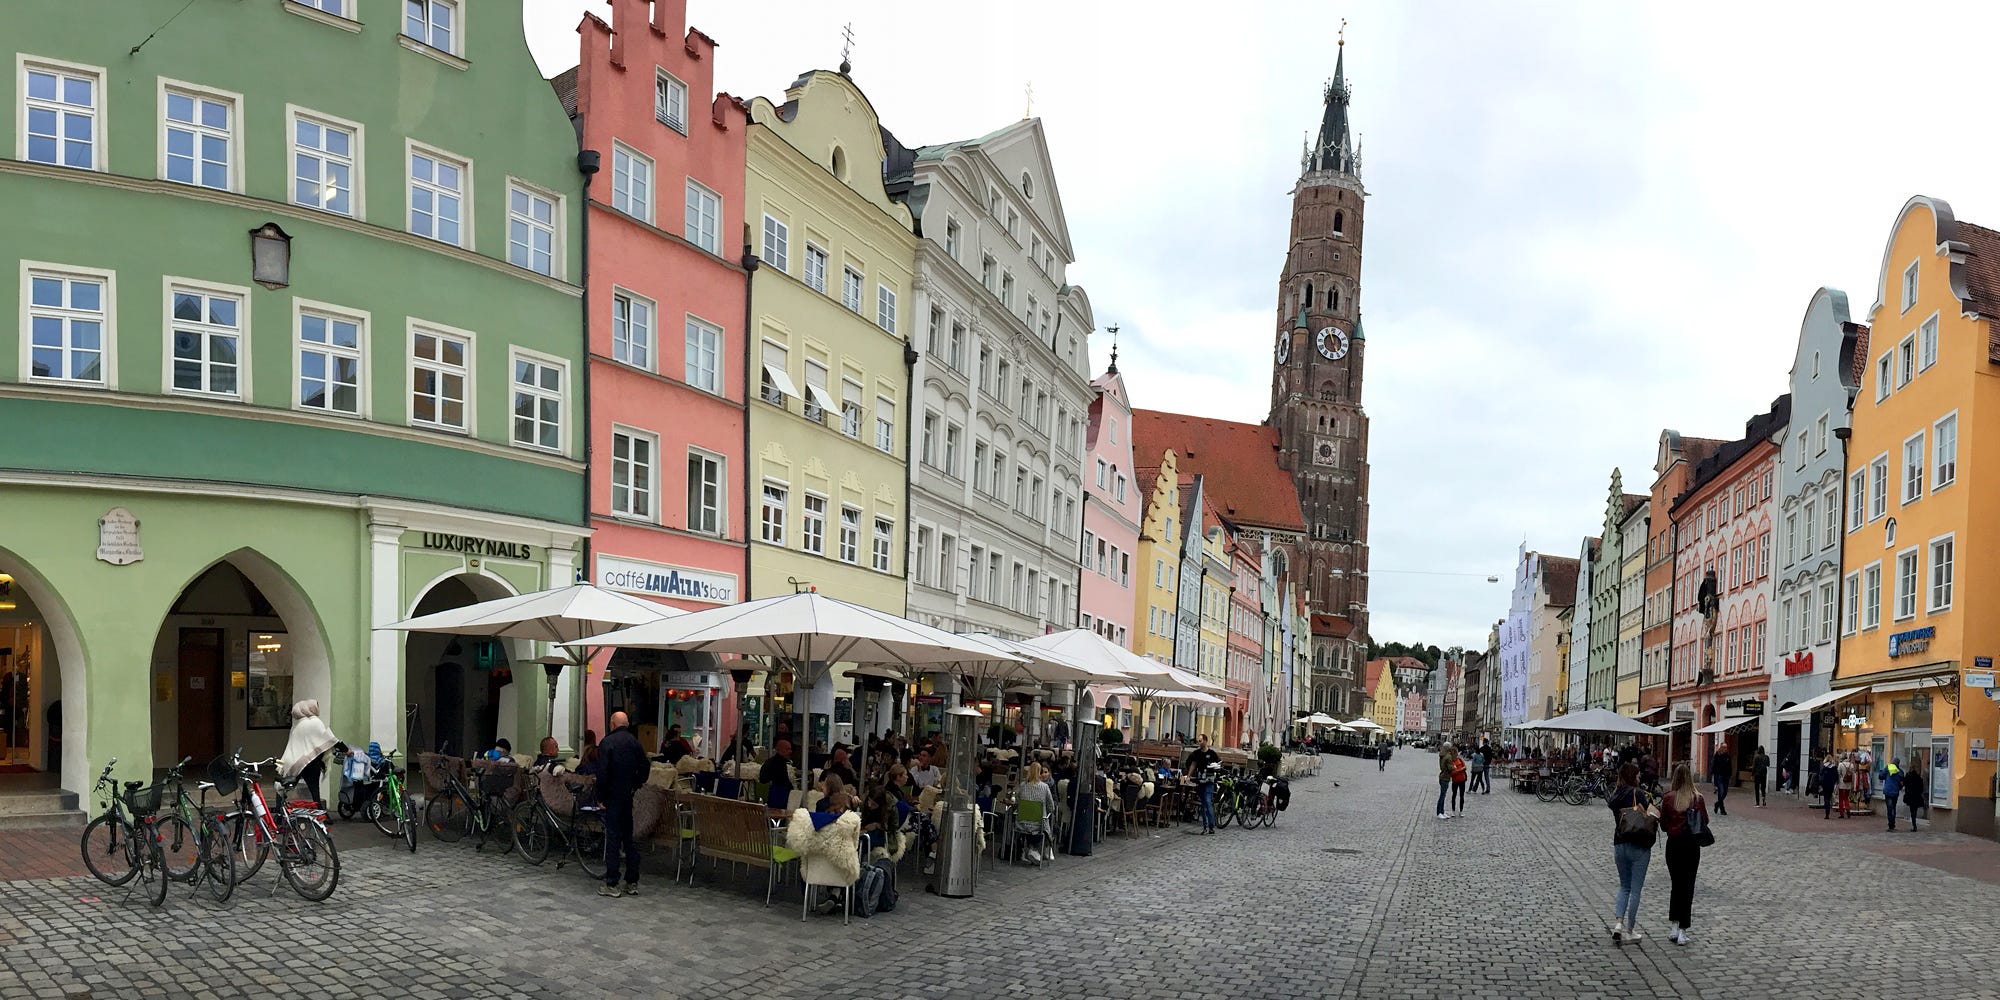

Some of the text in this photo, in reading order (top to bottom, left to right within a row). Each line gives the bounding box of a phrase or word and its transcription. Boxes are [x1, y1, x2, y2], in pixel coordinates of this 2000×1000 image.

[423, 532, 531, 560] LUXURY NAILS
[605, 570, 645, 590] caffé
[709, 582, 732, 600] bar
